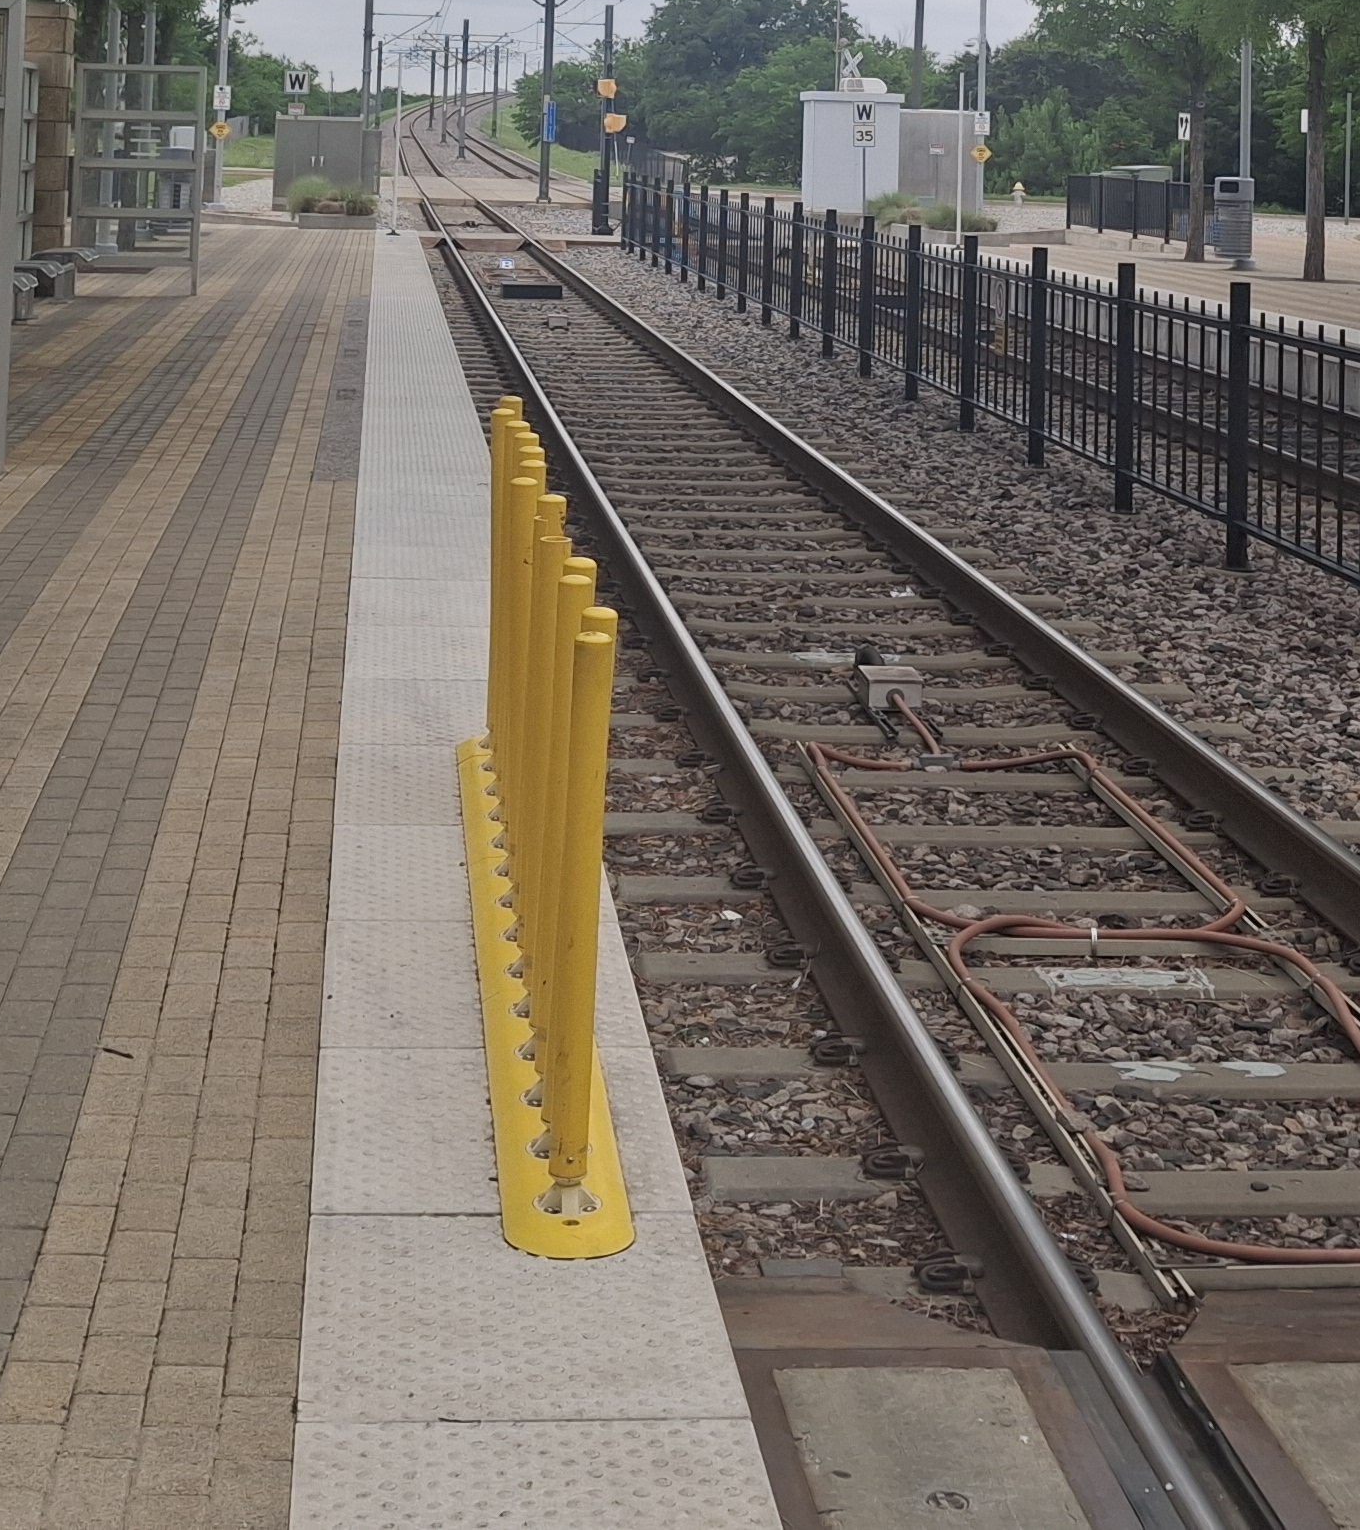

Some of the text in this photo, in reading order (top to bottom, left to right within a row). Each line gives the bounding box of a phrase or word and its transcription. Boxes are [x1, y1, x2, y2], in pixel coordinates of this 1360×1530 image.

[288, 73, 306, 90] W
[856, 104, 873, 120] W
[855, 130, 874, 142] 35
